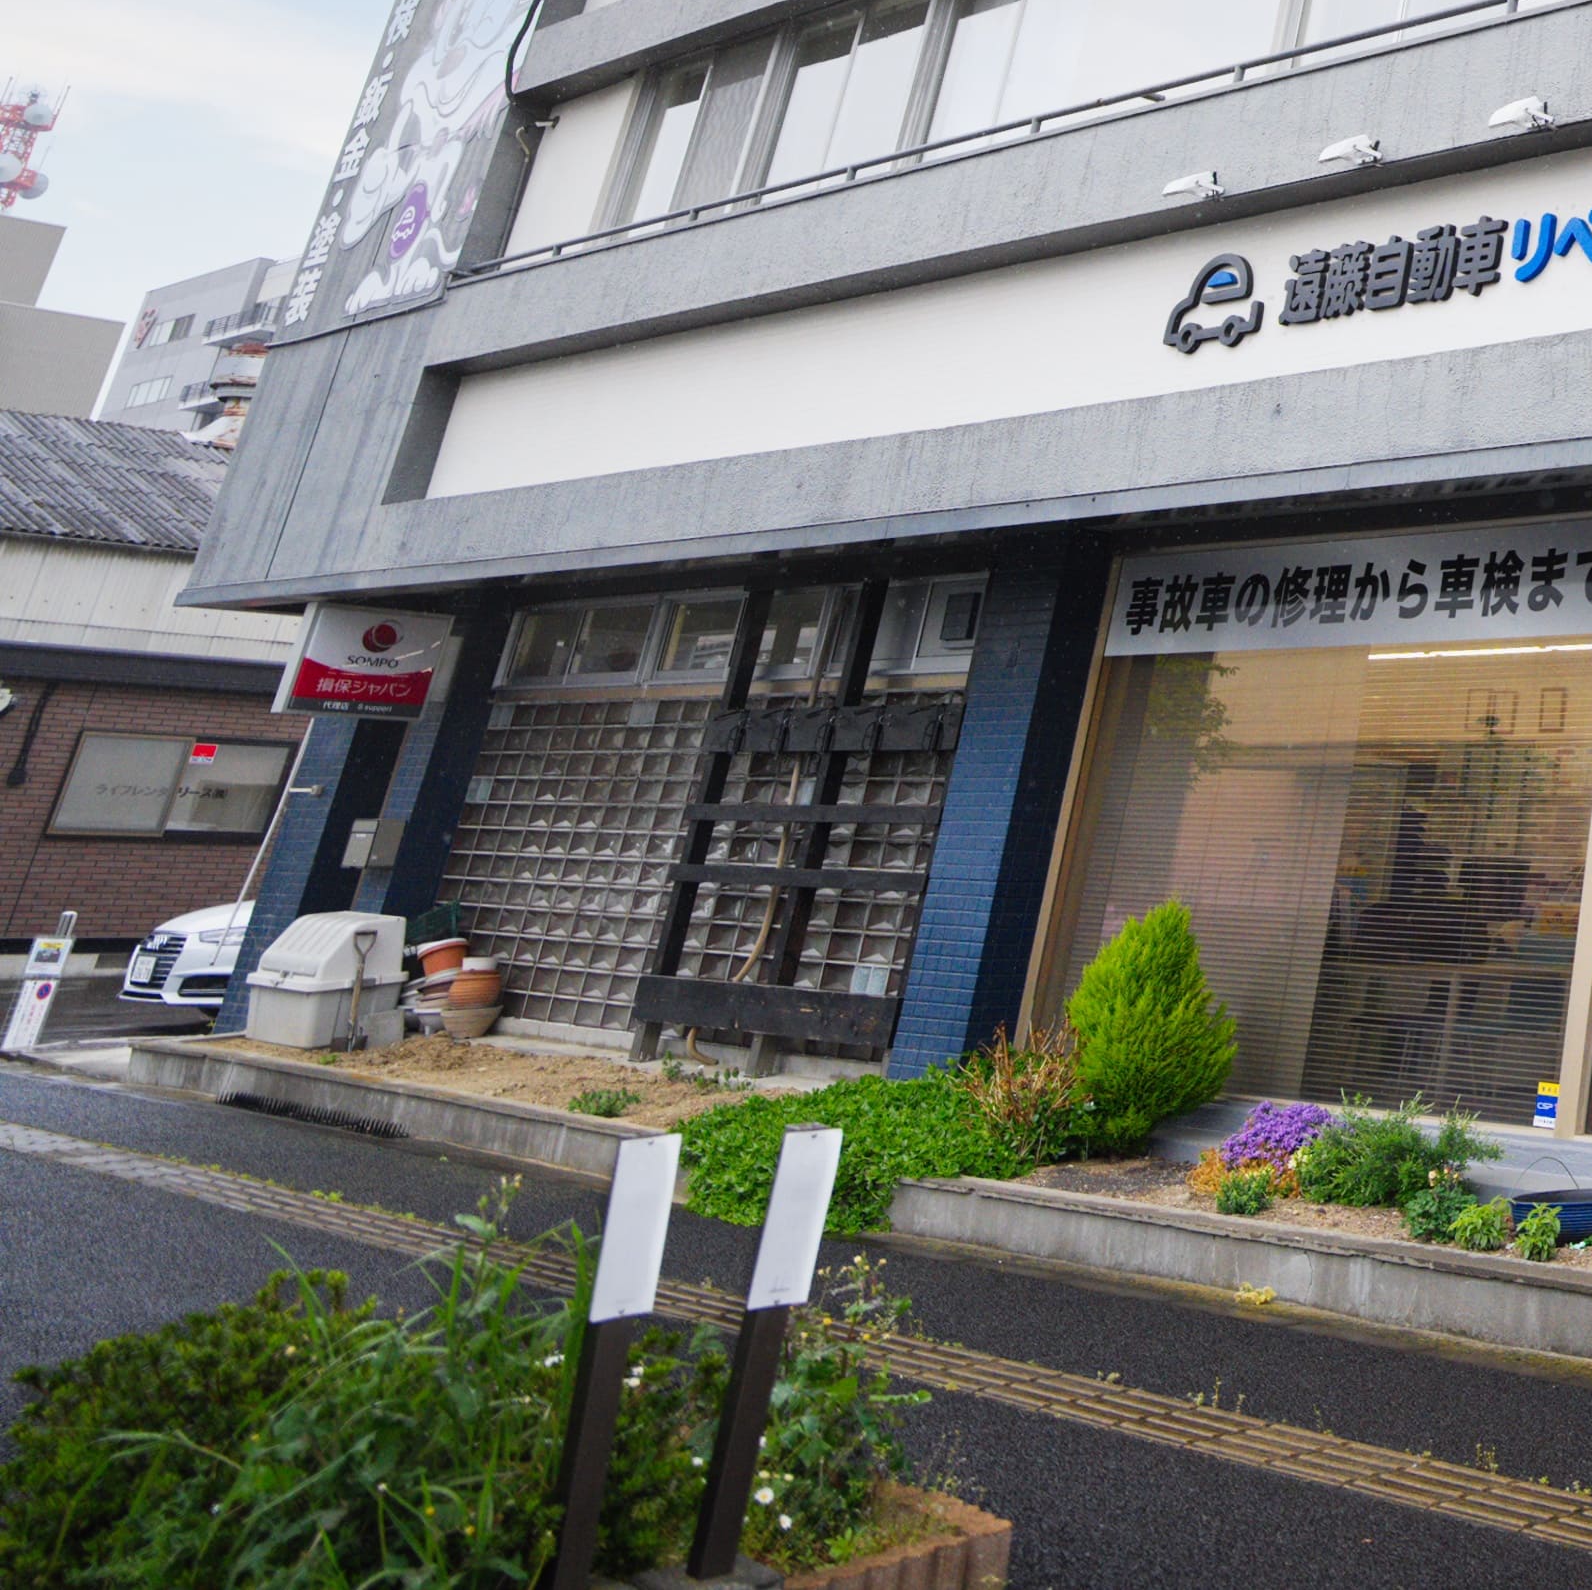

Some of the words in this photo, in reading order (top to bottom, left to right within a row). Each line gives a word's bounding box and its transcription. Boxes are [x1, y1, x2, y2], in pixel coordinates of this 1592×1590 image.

[347, 655, 399, 668] SOMPO
[316, 677, 412, 697] 損保ジャパン
[322, 701, 349, 711] 代理店
